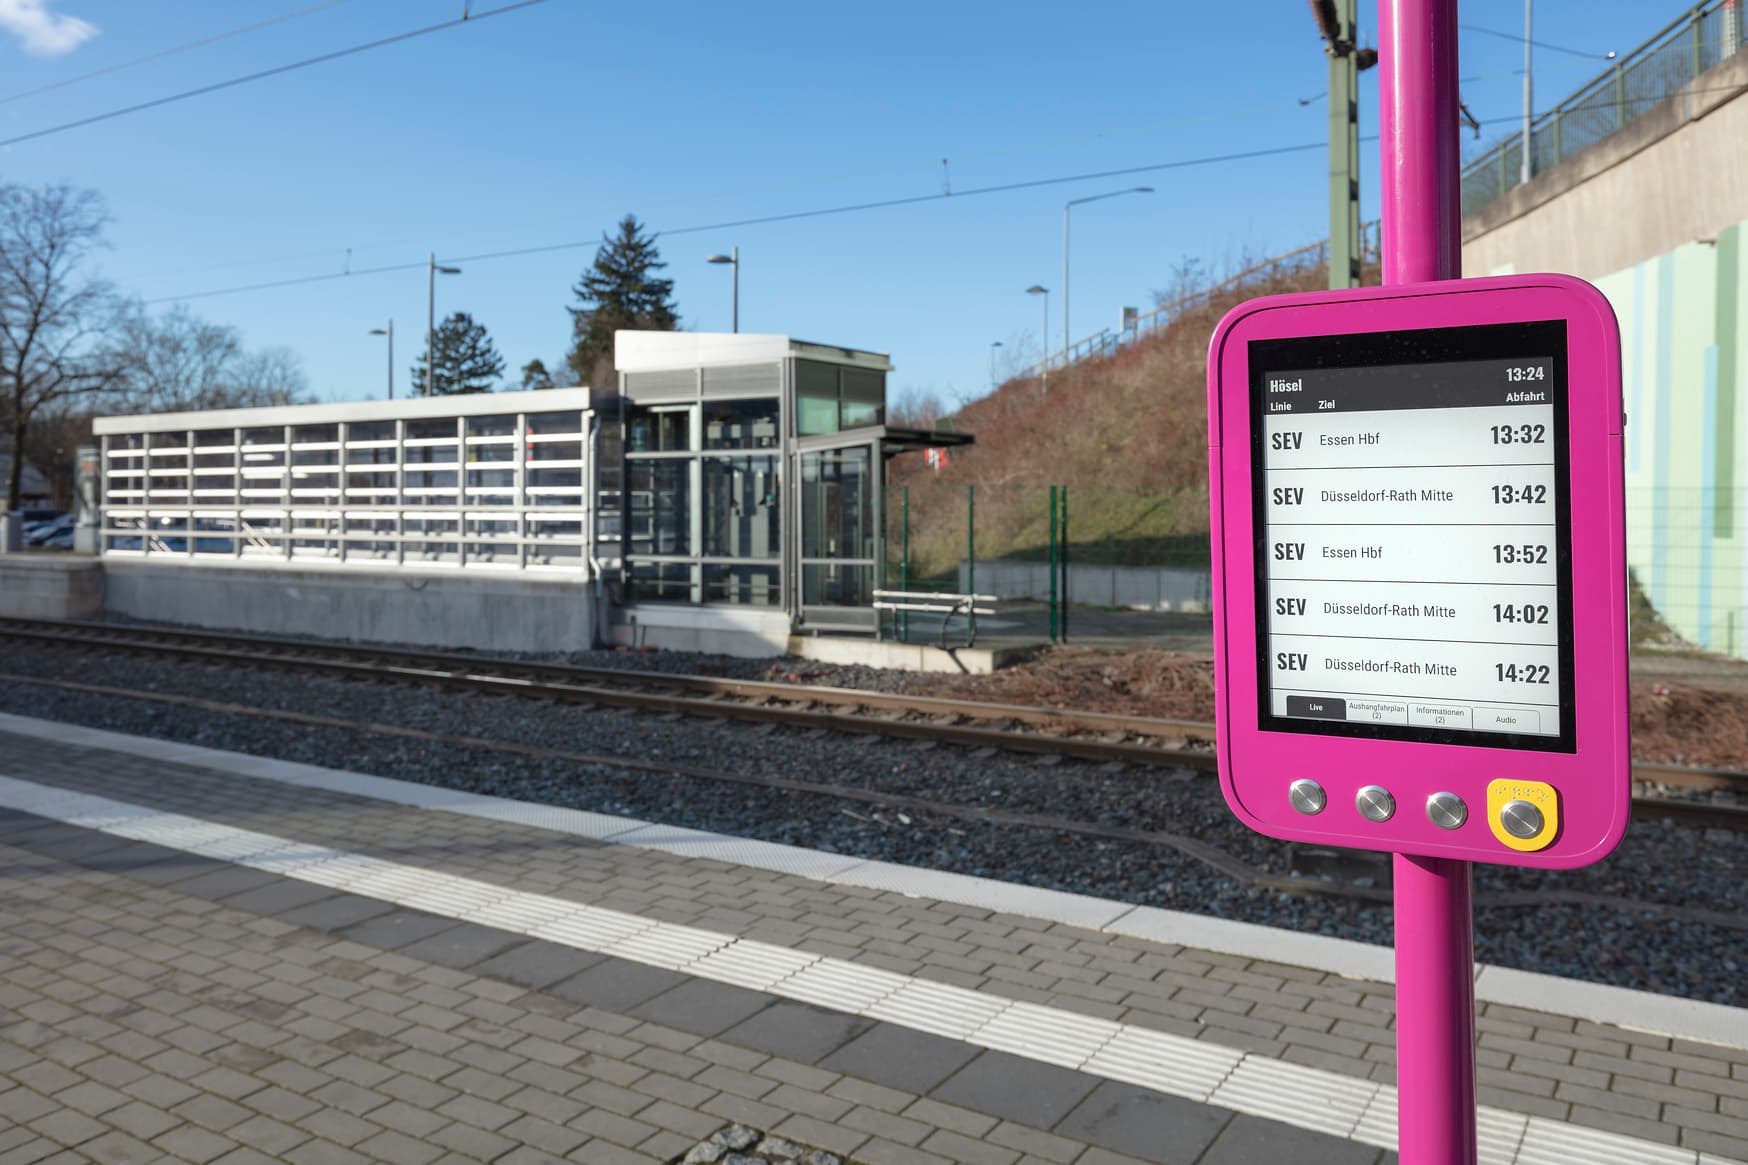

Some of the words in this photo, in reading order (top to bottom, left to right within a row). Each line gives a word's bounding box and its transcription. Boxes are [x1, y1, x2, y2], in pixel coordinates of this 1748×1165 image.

[1506, 367, 1544, 381] 13:24
[1270, 379, 1302, 392] Hösel
[1271, 402, 1291, 411] Linie
[1319, 400, 1335, 409] Ziel
[1506, 392, 1544, 402] Abfahrt
[1272, 432, 1302, 450] SEV
[1320, 435, 1354, 445] Essen
[1359, 432, 1380, 444] Hbf
[1491, 424, 1545, 444] 13:32
[1273, 488, 1303, 505] SEV
[1322, 489, 1416, 502] Düsseldorf-Rath
[1422, 490, 1453, 501] Mitte
[1492, 485, 1546, 504] 13:42
[1275, 543, 1305, 560] SEV
[1323, 547, 1356, 558] Essen
[1362, 547, 1382, 558] Hbf
[1493, 545, 1547, 564] 13:52
[1276, 598, 1306, 615] SEV
[1324, 603, 1419, 616] Düsseldorf-Rath
[1424, 606, 1455, 617] Mitte
[1493, 604, 1548, 624] 14:02
[1277, 653, 1307, 671] SEV
[1325, 658, 1420, 674] Düsseldorf-Rath
[1426, 664, 1456, 676] Mitte
[1496, 664, 1550, 684] 14:22
[1349, 702, 1405, 714] Aushangfahrplan
[1417, 706, 1465, 717] Informationen
[1371, 712, 1382, 721] (2)
[1435, 716, 1445, 725] (2)
[1496, 716, 1516, 724] Audio
